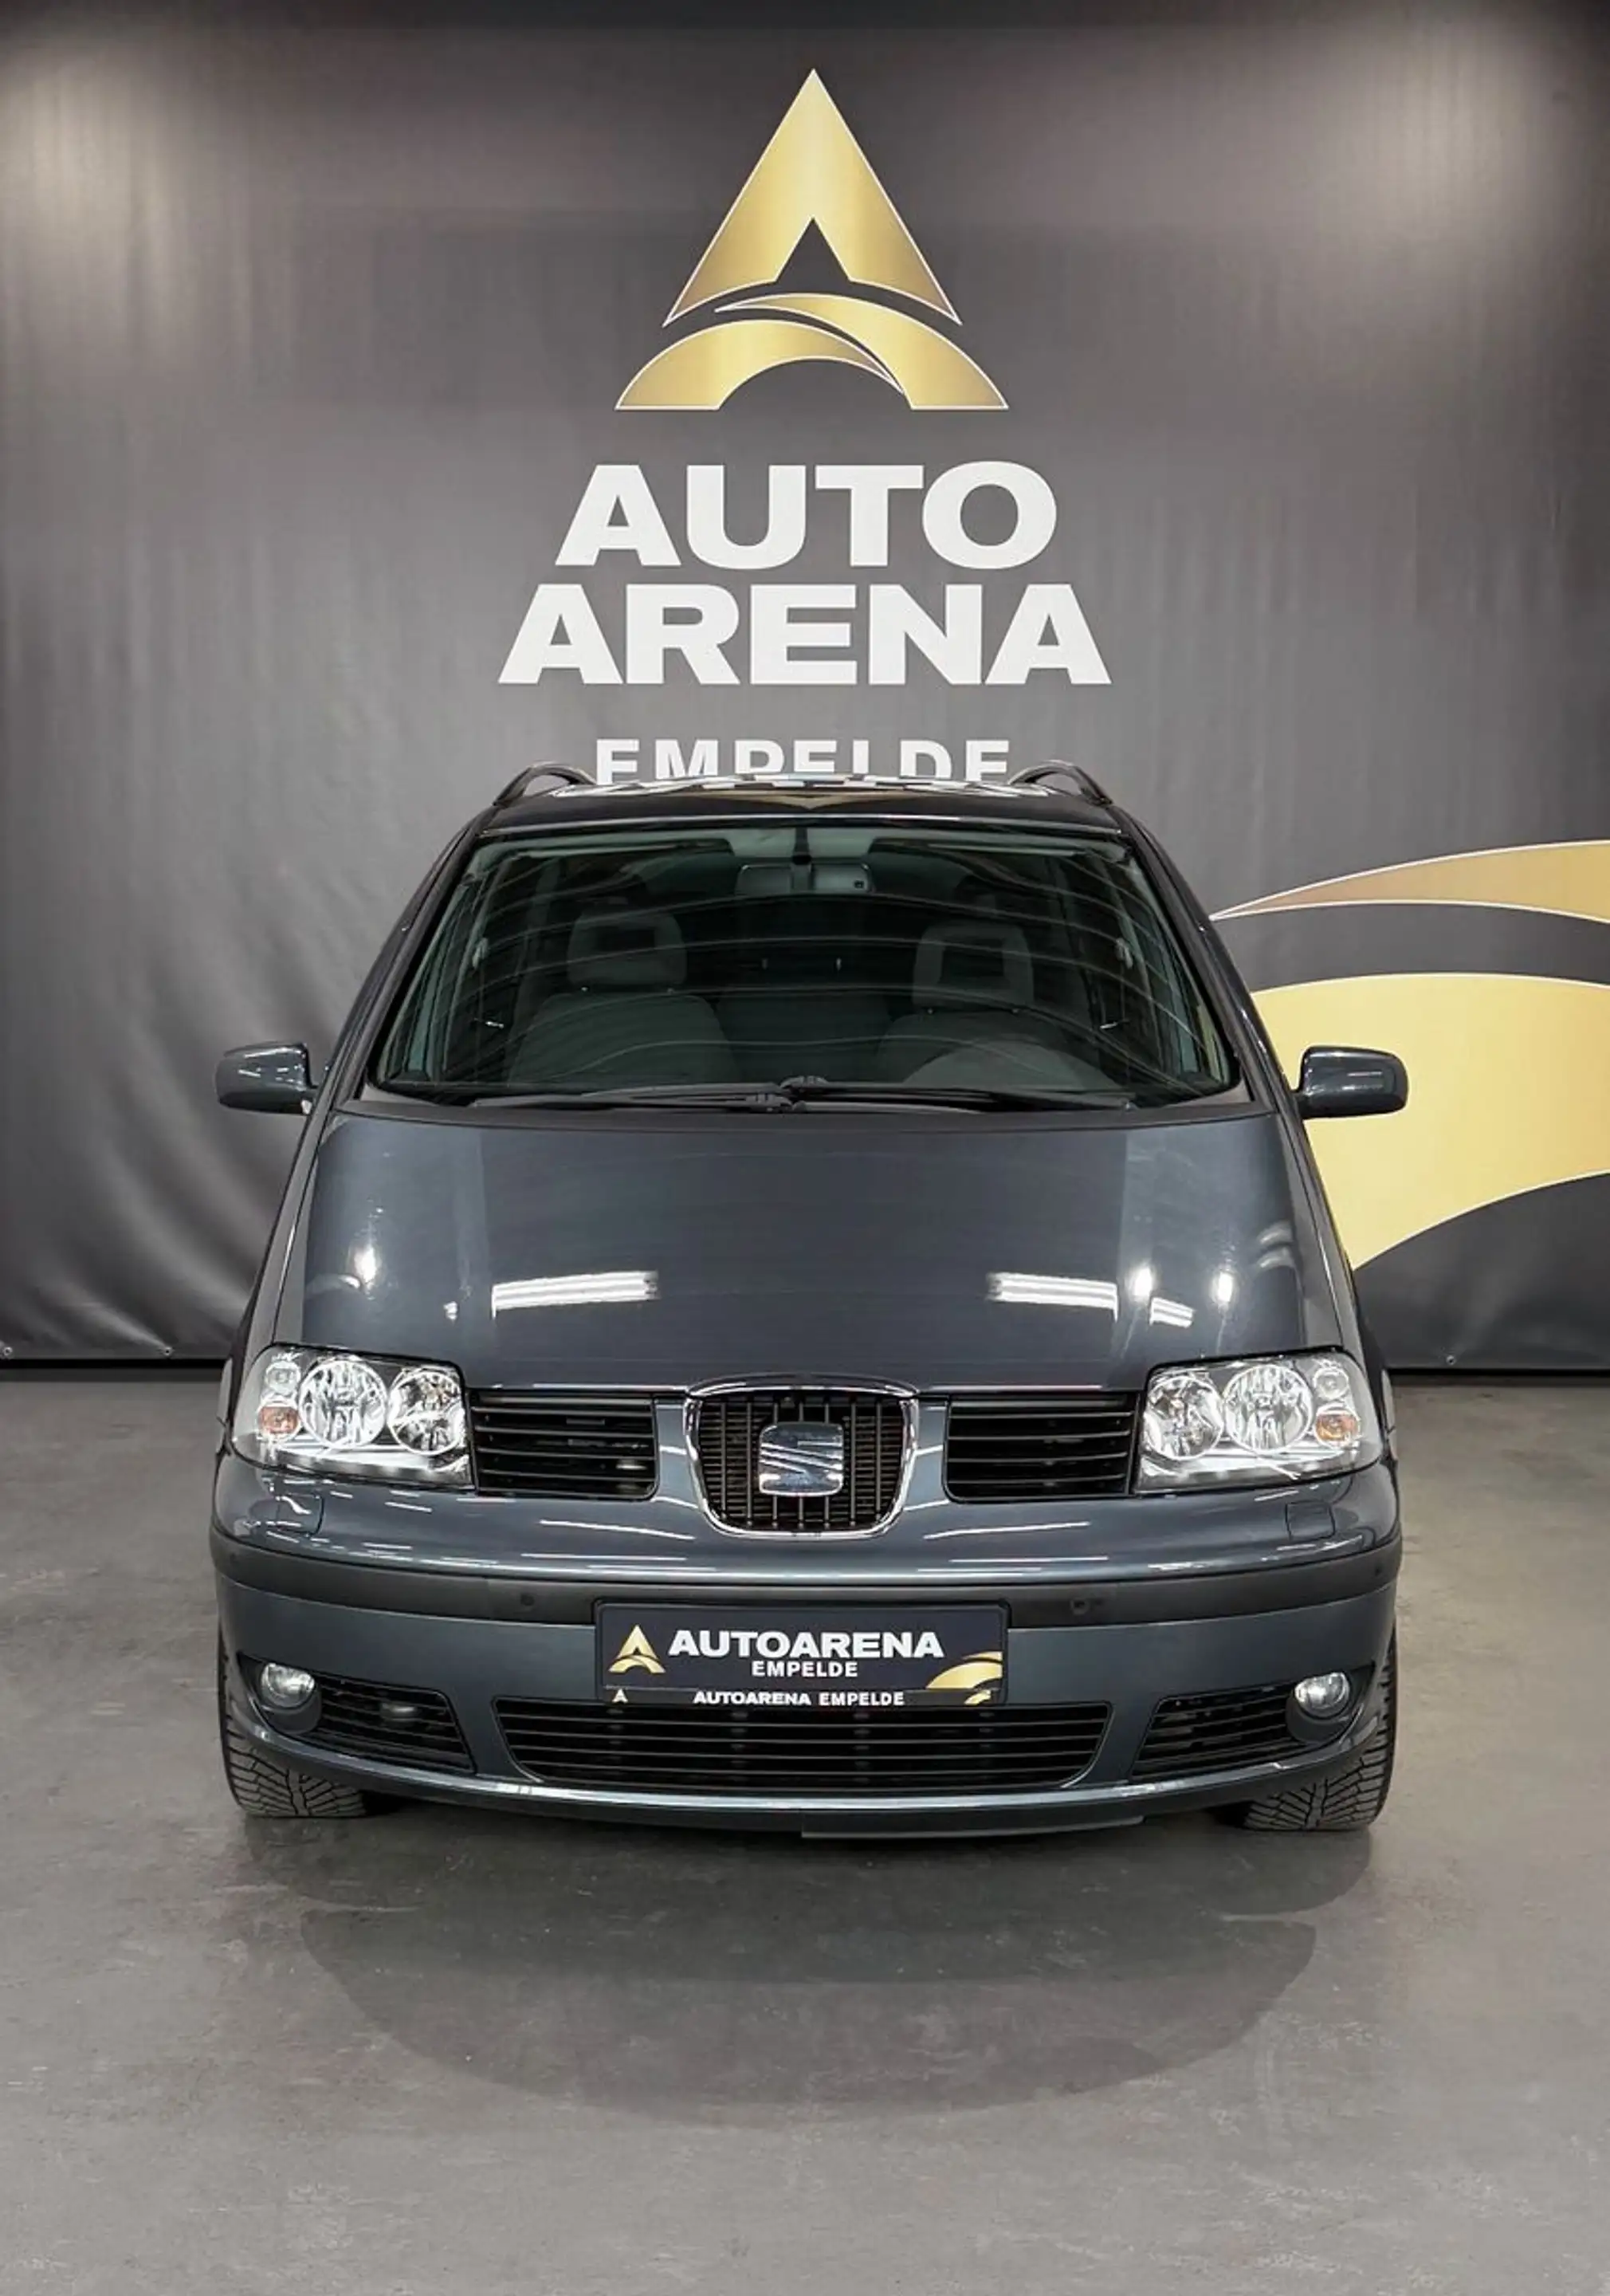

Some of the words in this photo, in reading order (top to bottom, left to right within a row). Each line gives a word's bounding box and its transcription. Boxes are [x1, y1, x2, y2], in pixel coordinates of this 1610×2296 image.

[555, 461, 1057, 569] AUTO
[497, 584, 1112, 684] ARENA
[668, 1630, 944, 1658] AUTOARENA
[752, 1660, 858, 1677] EMPELDE
[693, 1690, 812, 1705] AUTOARENA
[819, 1691, 905, 1706] EMPELDE
